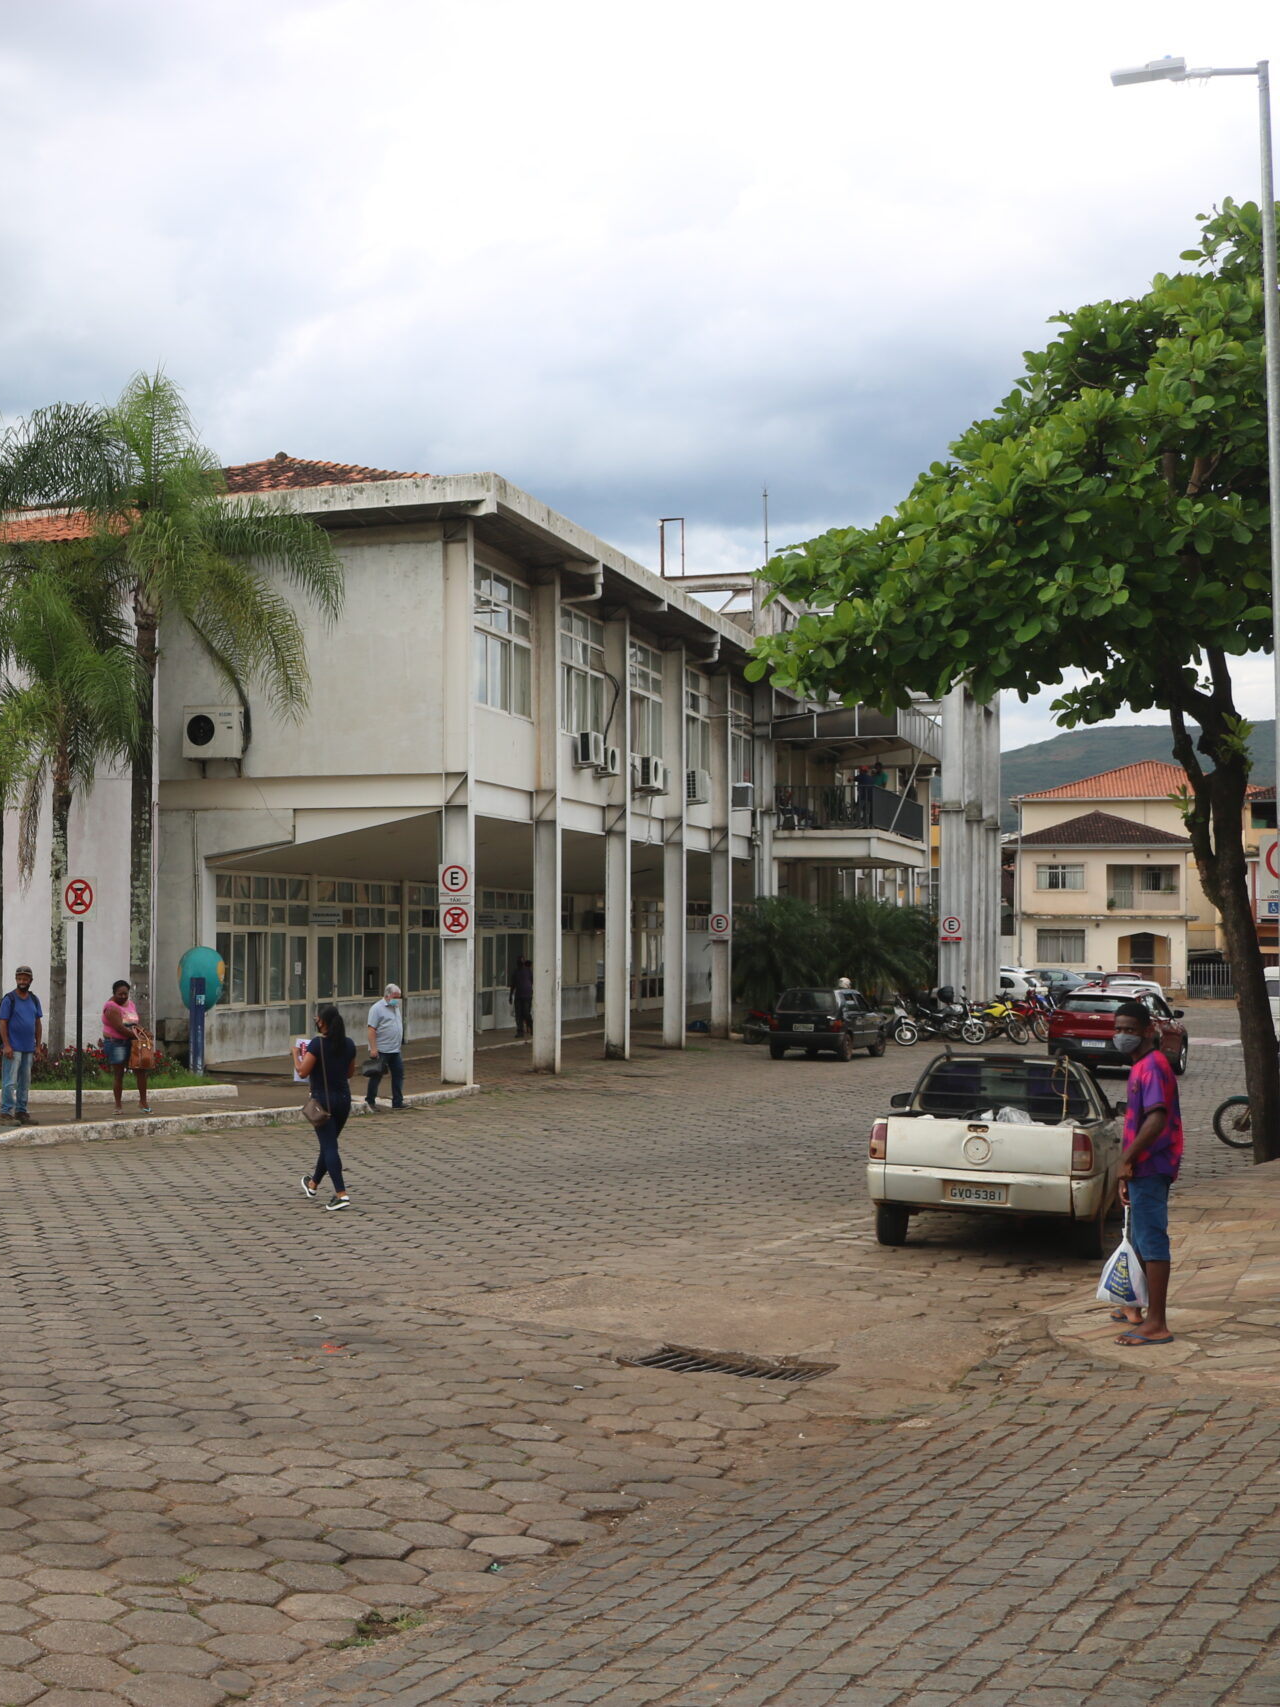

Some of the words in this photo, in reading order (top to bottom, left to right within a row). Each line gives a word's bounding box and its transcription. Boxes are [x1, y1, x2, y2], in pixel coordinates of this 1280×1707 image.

[450, 871, 460, 886] E
[716, 918, 723, 929] E
[948, 920, 955, 930] E
